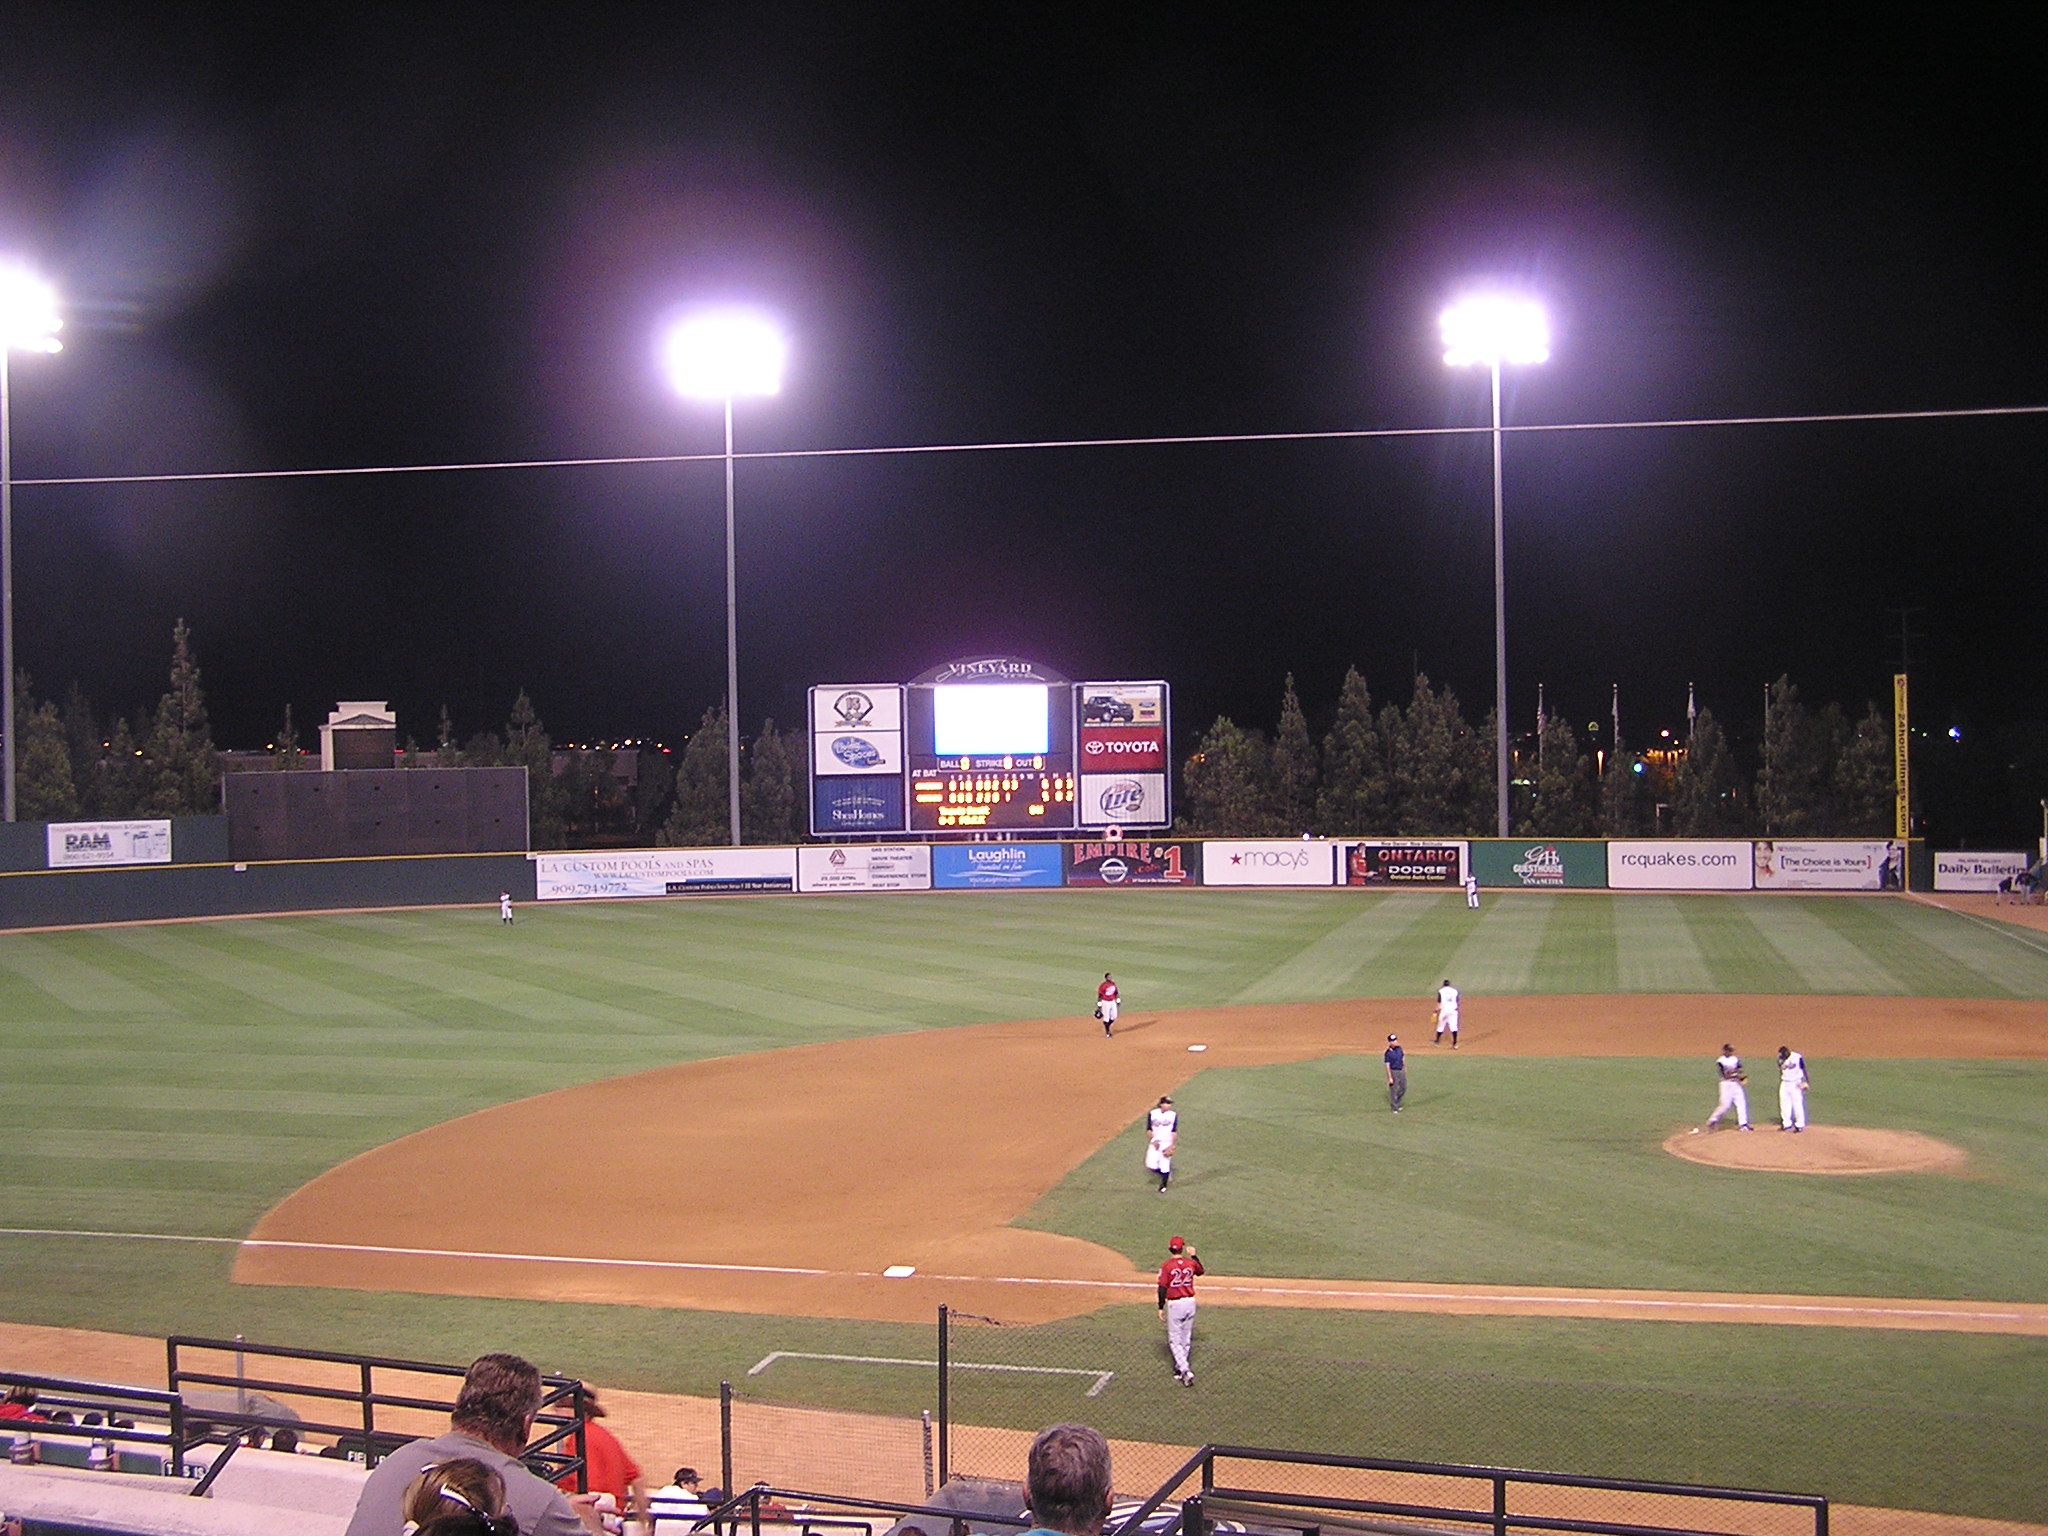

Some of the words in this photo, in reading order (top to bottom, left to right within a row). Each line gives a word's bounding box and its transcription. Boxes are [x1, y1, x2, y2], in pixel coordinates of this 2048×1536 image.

[948, 663, 1032, 674] VINEYARD
[1104, 740, 1160, 753] TOYOTA
[940, 760, 961, 768] BALL
[975, 760, 1004, 768] STRIKE
[1016, 760, 1032, 768] OUT
[923, 769, 938, 777] BAT
[968, 848, 1026, 862] Laughlin
[1073, 843, 1152, 865] EMPIRE
[1244, 849, 1310, 870] macy's
[1377, 849, 1458, 861] ONTARIO
[1621, 852, 1737, 868] rcquakes.com
[563, 861, 617, 873] CUSTOM
[621, 859, 661, 871] POOLS
[686, 858, 714, 868] SPAS
[1802, 857, 1832, 866] Choice
[1833, 857, 1841, 866] is
[1388, 866, 1448, 874] DODGE
[1938, 863, 1972, 875] Daily
[1170, 1267, 1194, 1287] 22
[166, 1463, 190, 1477] TS
